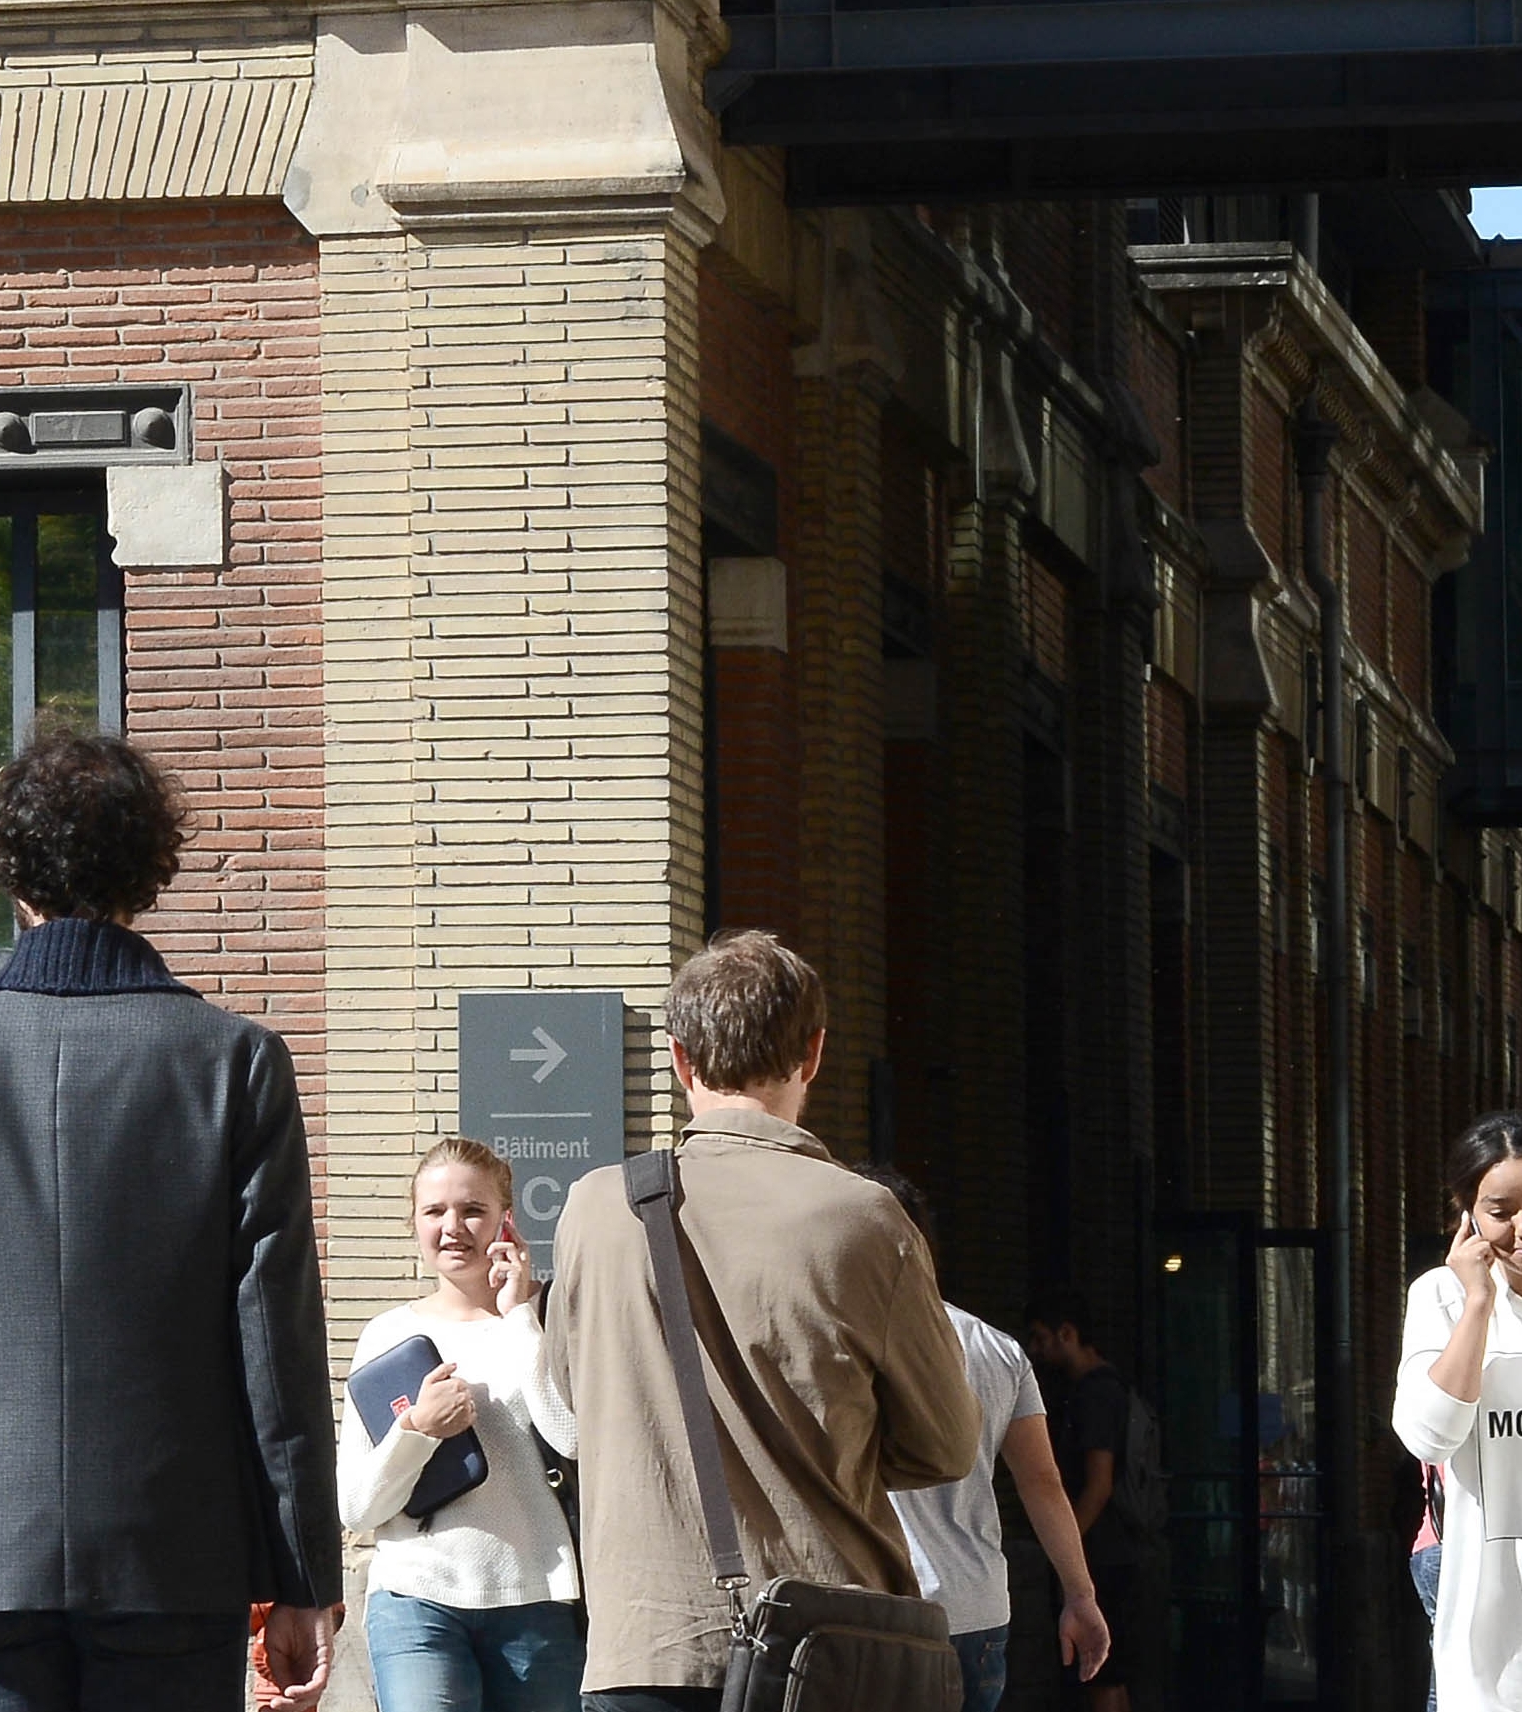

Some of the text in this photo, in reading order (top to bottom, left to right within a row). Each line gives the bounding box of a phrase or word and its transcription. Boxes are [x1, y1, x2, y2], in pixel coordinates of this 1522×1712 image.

[494, 1136, 590, 1159] Bâtiment
[522, 1176, 561, 1221] C
[1489, 1410, 1522, 1438] M
